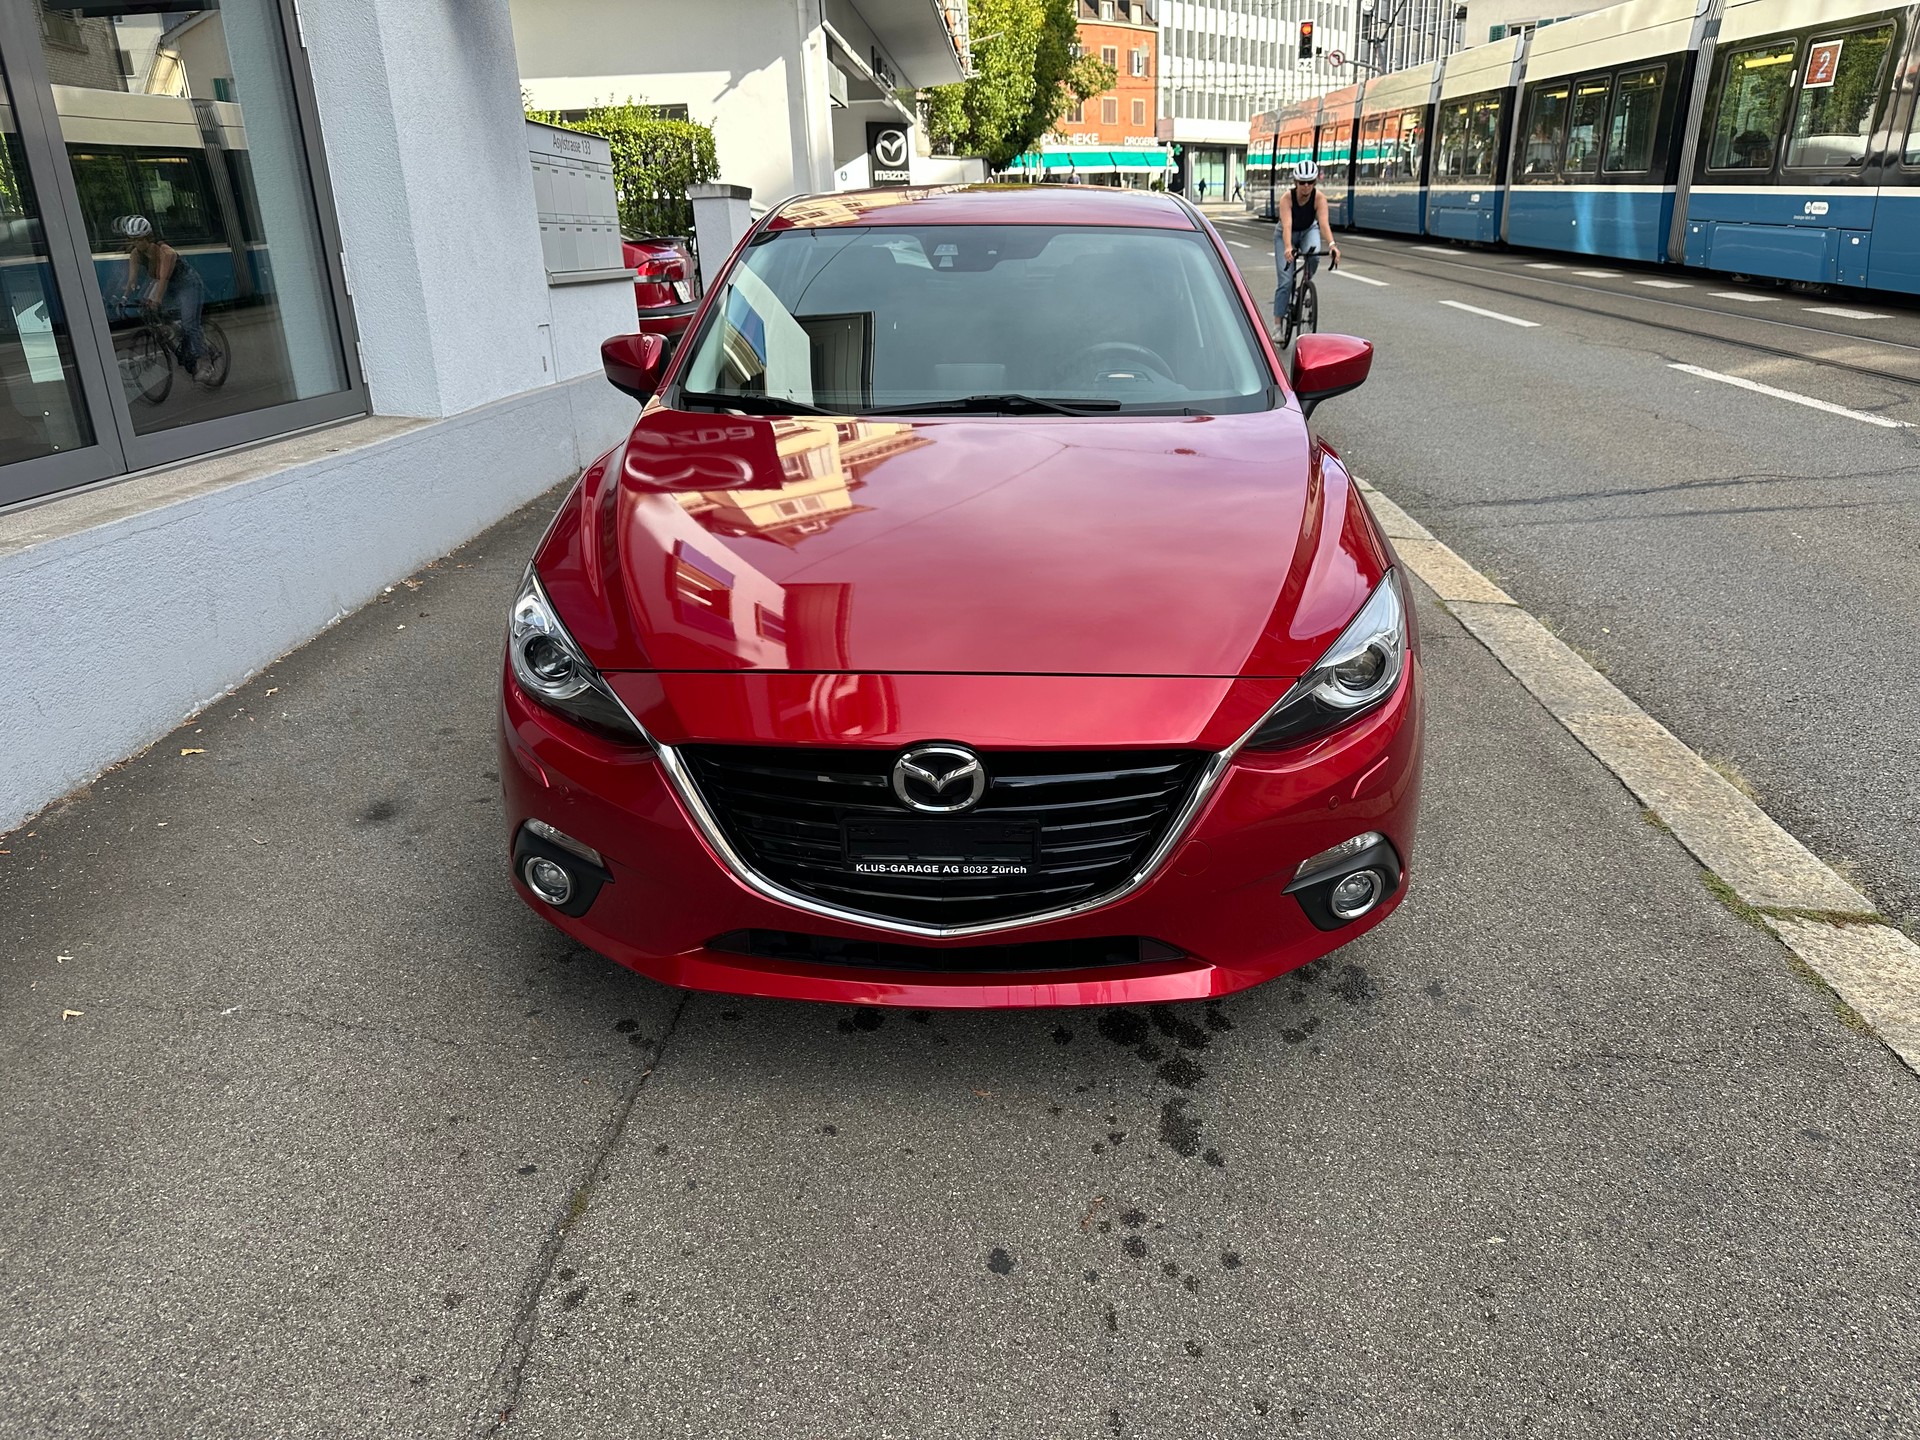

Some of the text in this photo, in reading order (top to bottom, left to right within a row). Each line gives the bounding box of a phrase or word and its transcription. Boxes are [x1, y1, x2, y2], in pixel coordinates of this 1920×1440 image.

[1817, 51, 1831, 79] 2
[553, 134, 591, 155] Asylstrasse 133
[1124, 136, 1159, 147] DROGERIE
[856, 863, 1027, 875] KLUS-GARAGE AG 8032 Zürich
